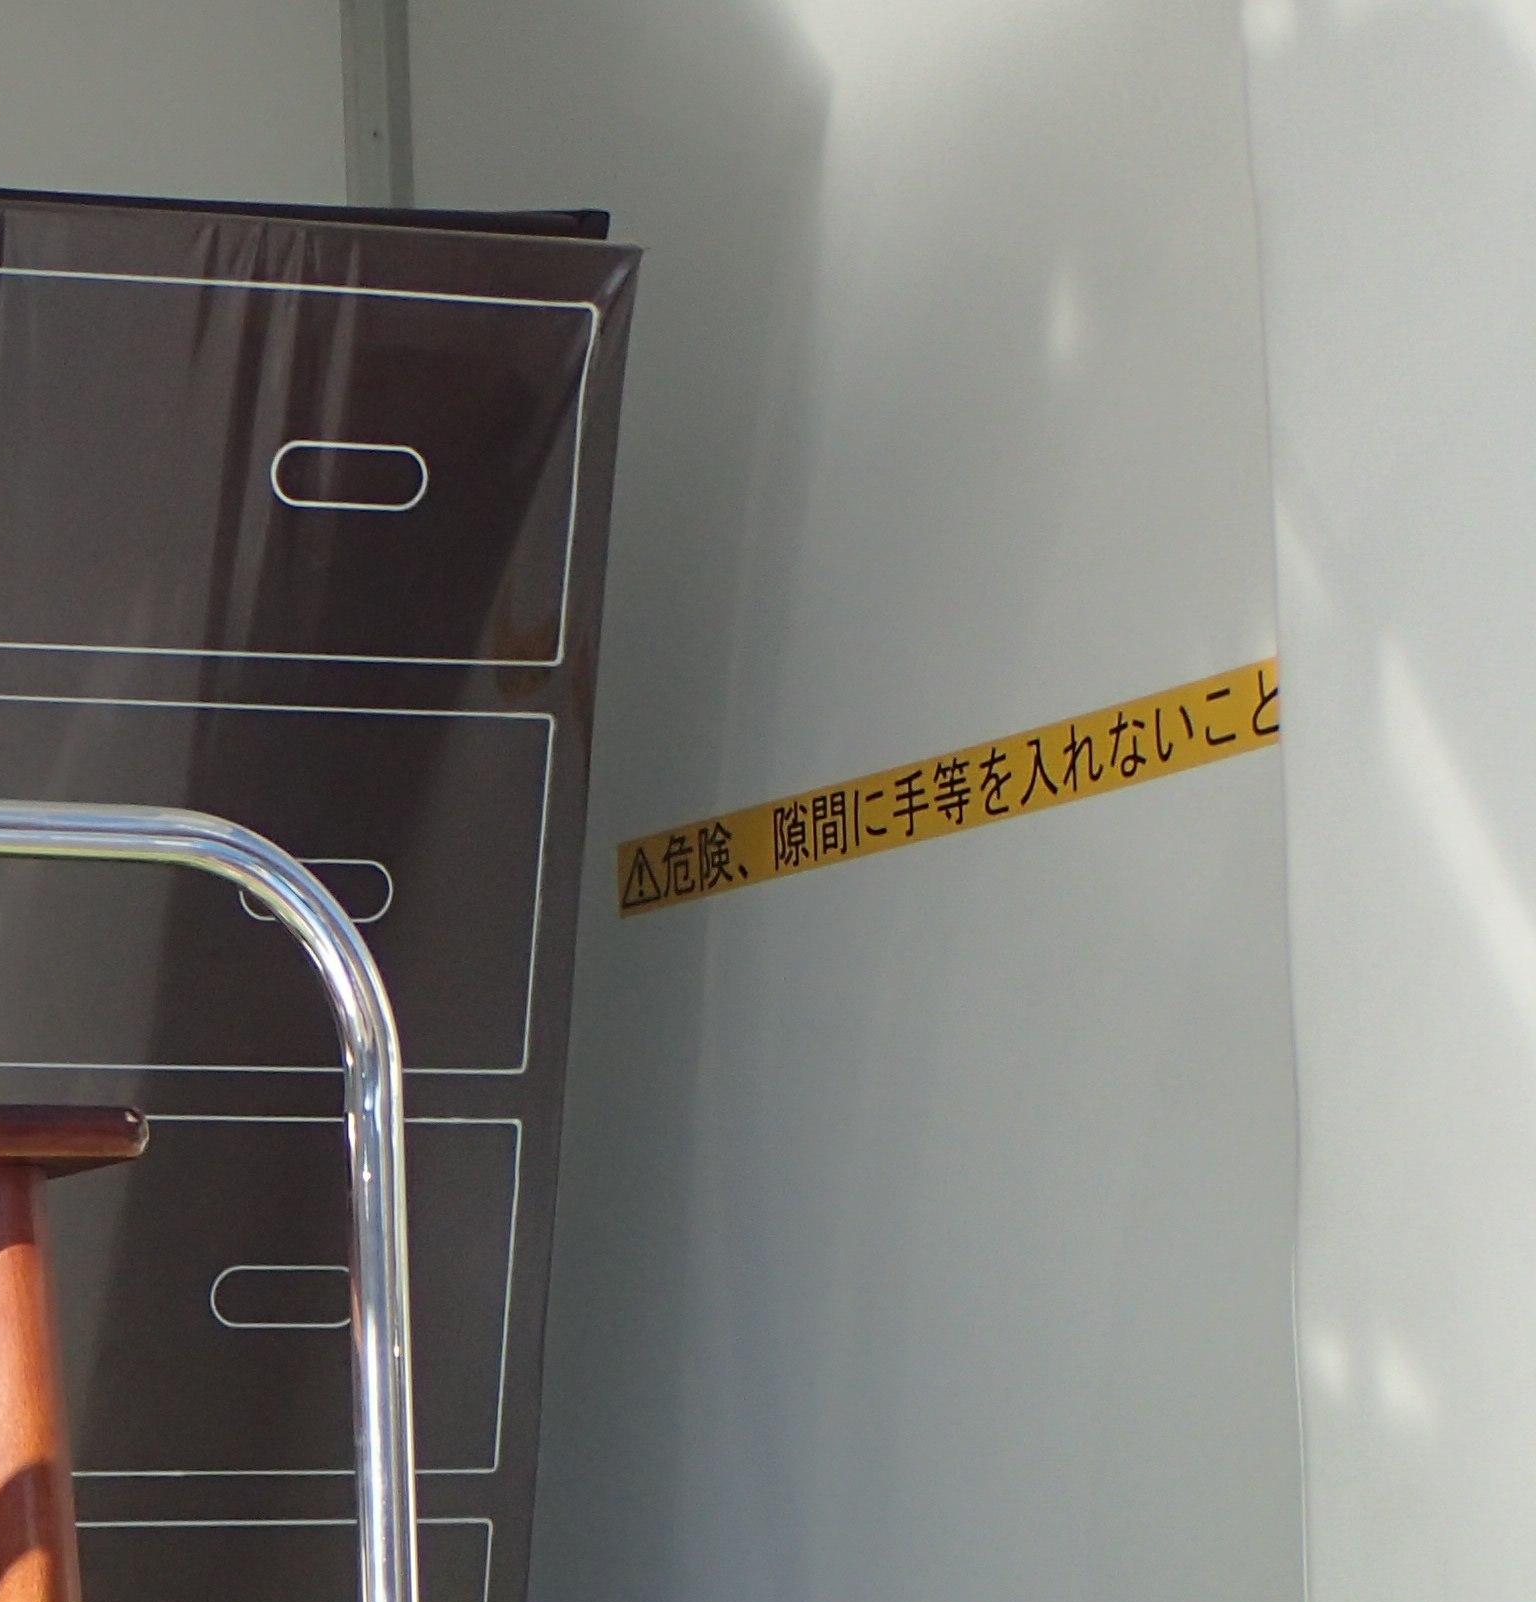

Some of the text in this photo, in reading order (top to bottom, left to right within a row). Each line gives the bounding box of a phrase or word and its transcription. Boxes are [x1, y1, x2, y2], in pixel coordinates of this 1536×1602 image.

[662, 670, 1279, 897] 危険、隙間に手等を入れないこと
